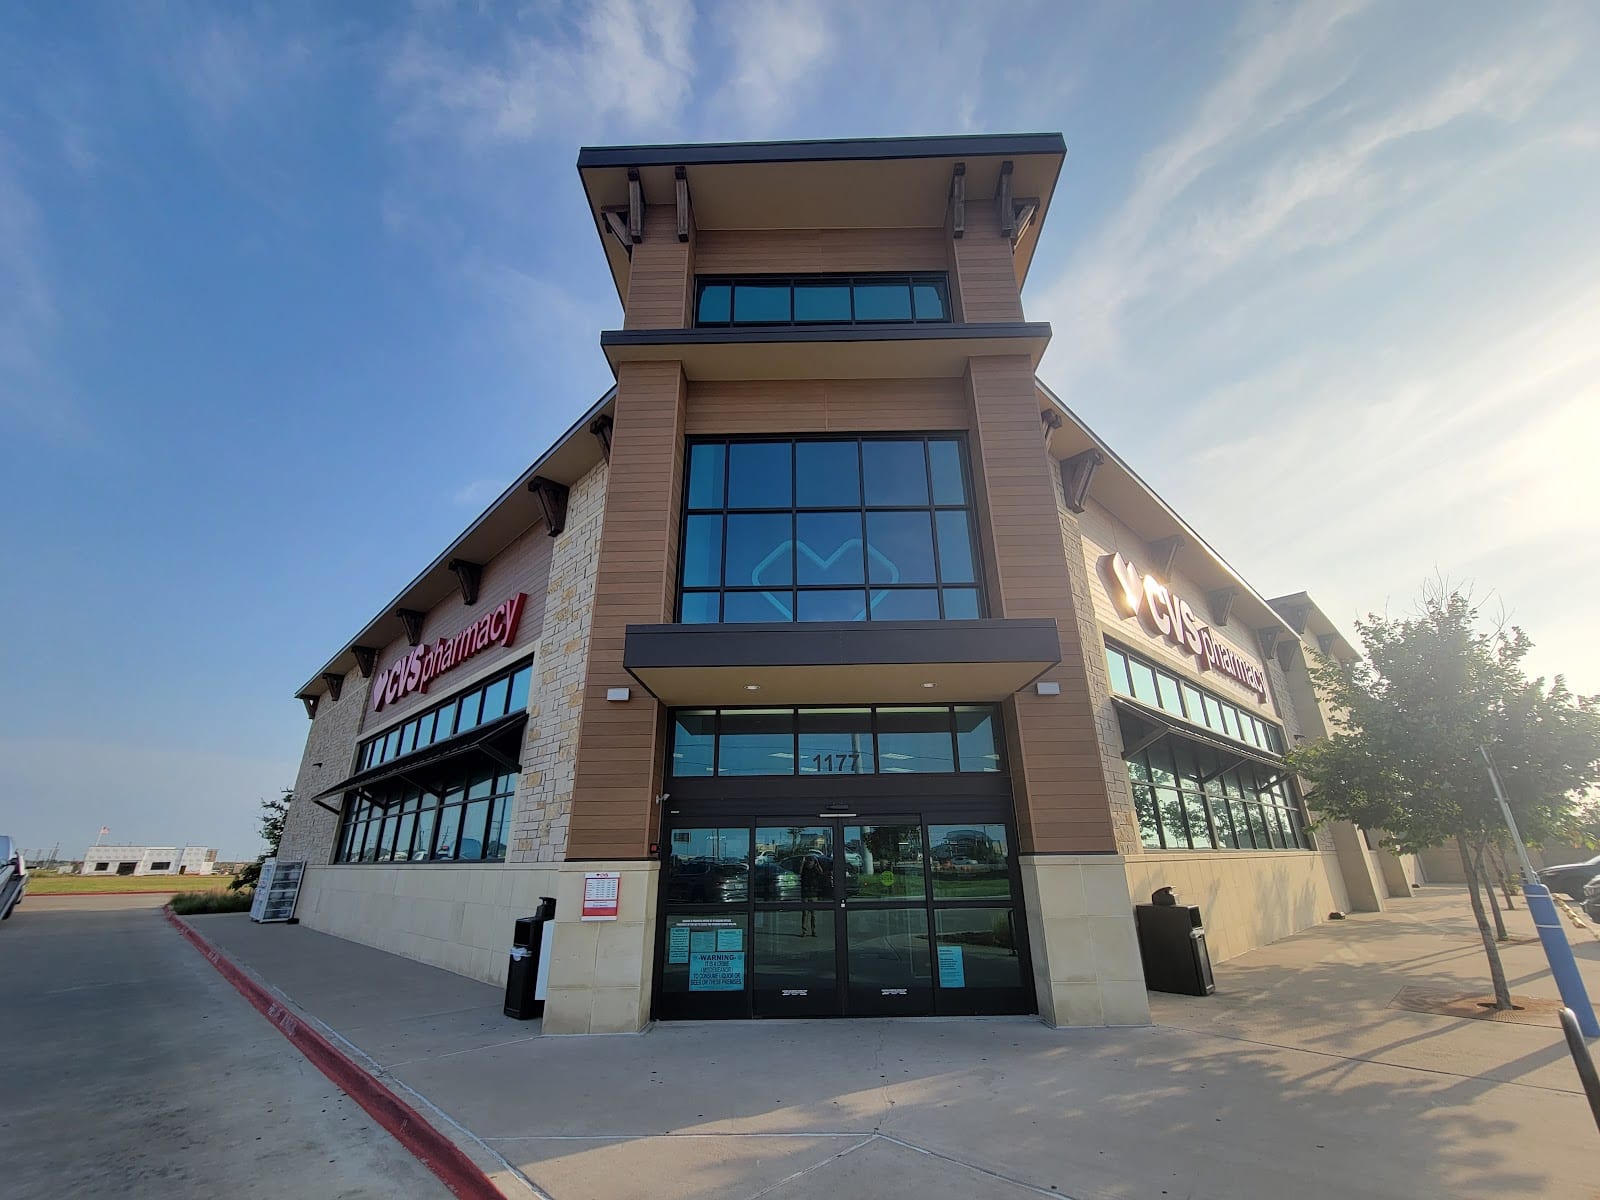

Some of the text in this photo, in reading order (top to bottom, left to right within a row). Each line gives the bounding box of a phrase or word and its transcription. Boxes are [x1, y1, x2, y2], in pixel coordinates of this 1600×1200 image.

[384, 592, 527, 705] CVS pharmacy
[1142, 573, 1268, 703] CVS pharmacy
[812, 754, 860, 772] 1177
